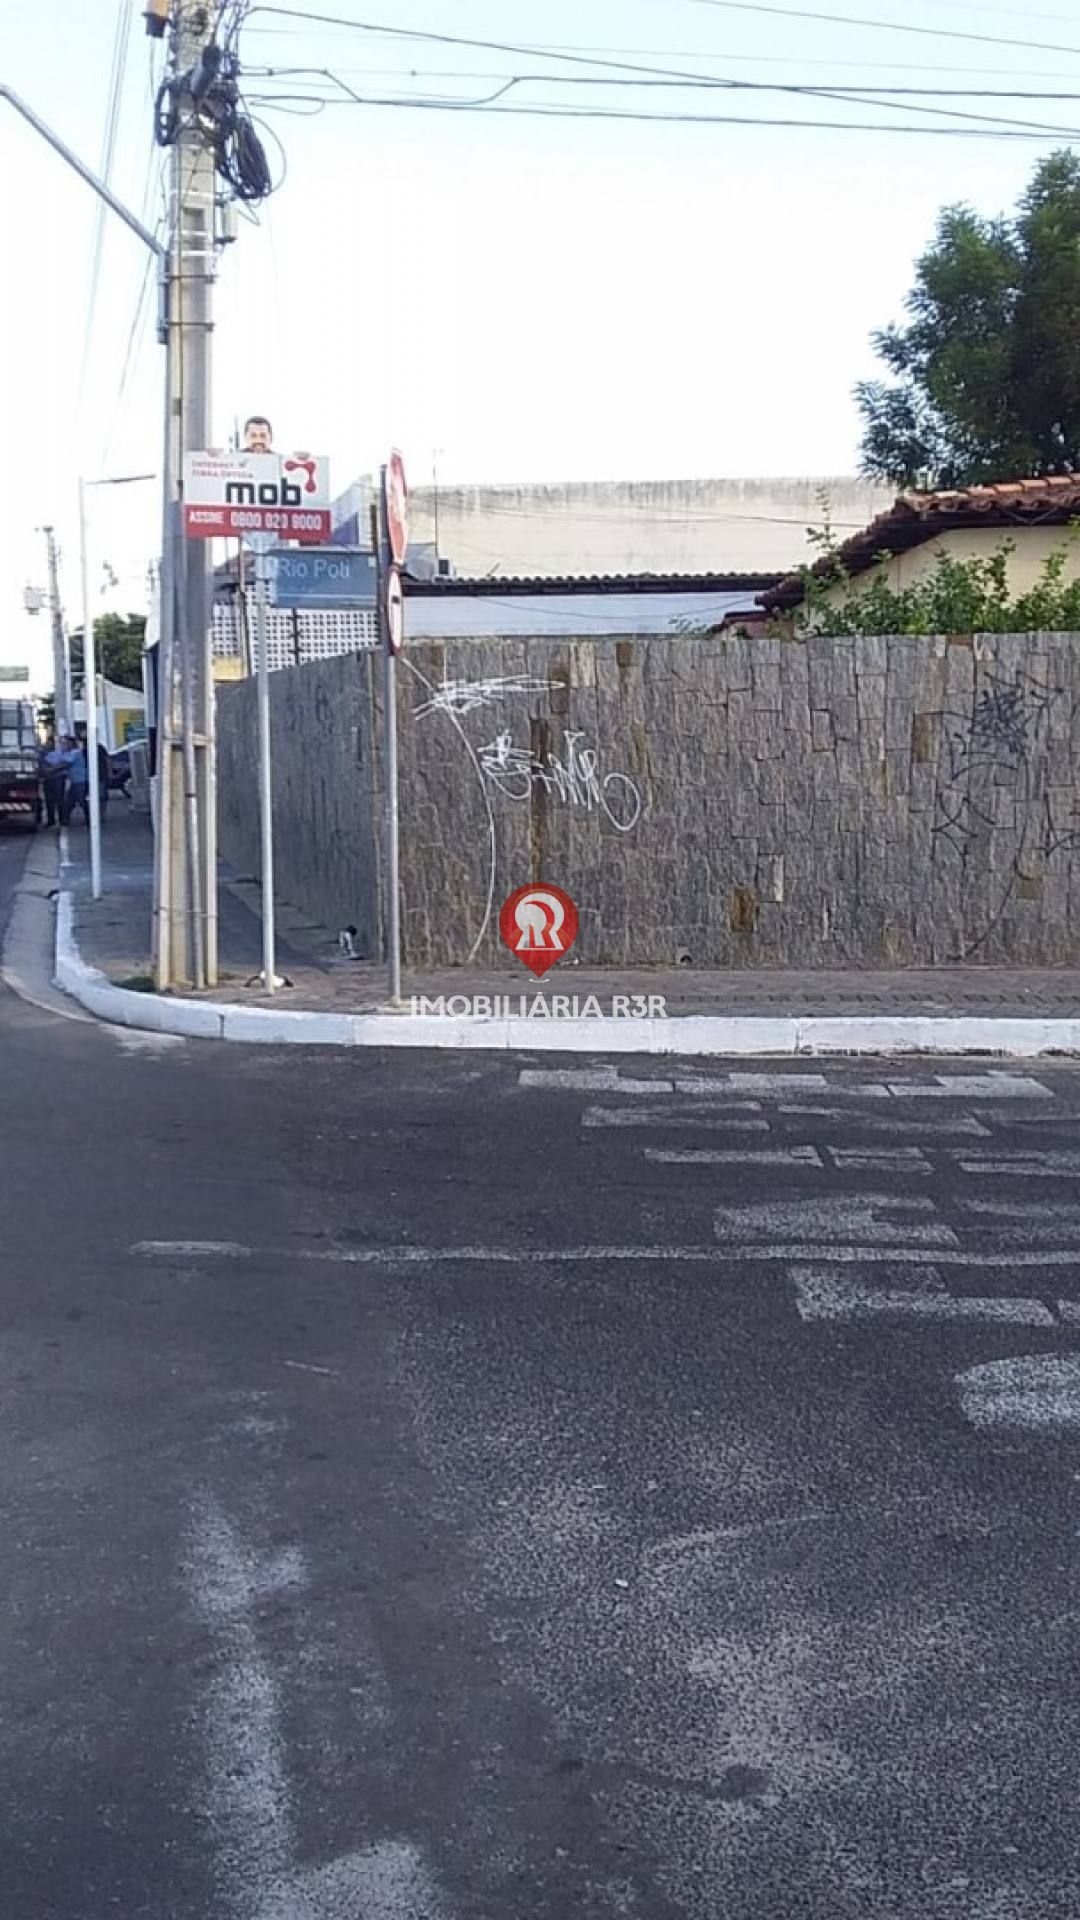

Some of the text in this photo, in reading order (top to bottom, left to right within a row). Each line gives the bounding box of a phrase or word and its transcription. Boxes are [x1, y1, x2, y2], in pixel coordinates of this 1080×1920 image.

[225, 477, 302, 507] mob
[230, 510, 262, 528] 0800
[291, 512, 323, 532] 9000
[278, 556, 309, 578] Rio
